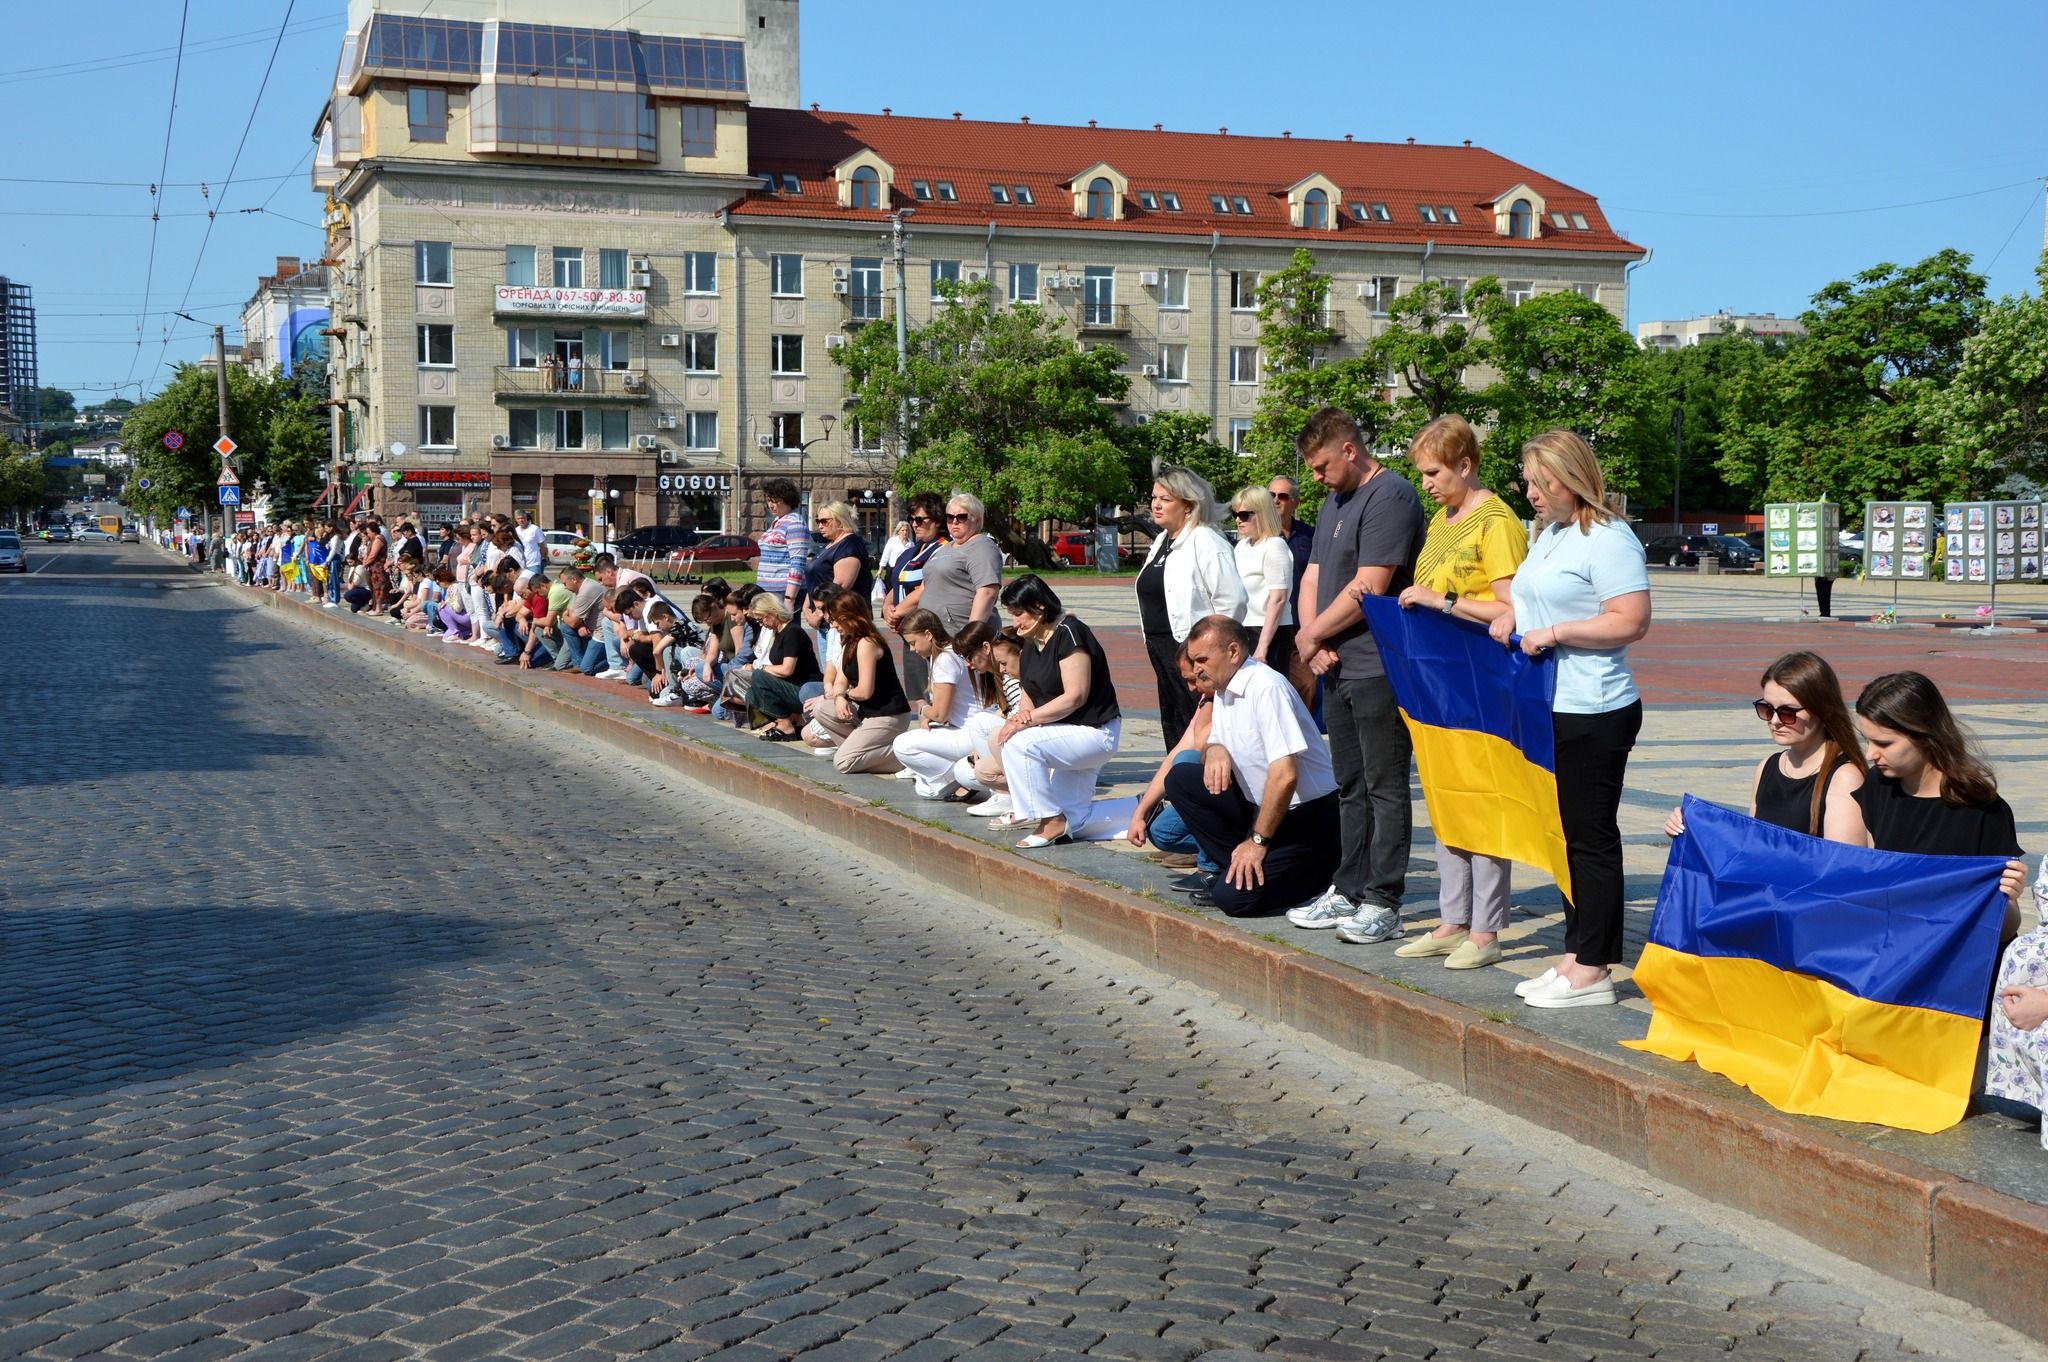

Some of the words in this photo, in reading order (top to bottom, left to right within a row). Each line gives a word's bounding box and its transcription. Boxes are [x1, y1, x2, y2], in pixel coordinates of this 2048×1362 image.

[498, 288, 552, 301] ОРЕНДА
[555, 290, 643, 304] 067-500-80-30
[557, 303, 590, 311] ОФІСНИХ
[404, 471, 462, 481] АПТЕКА
[659, 475, 730, 490] GOGOL
